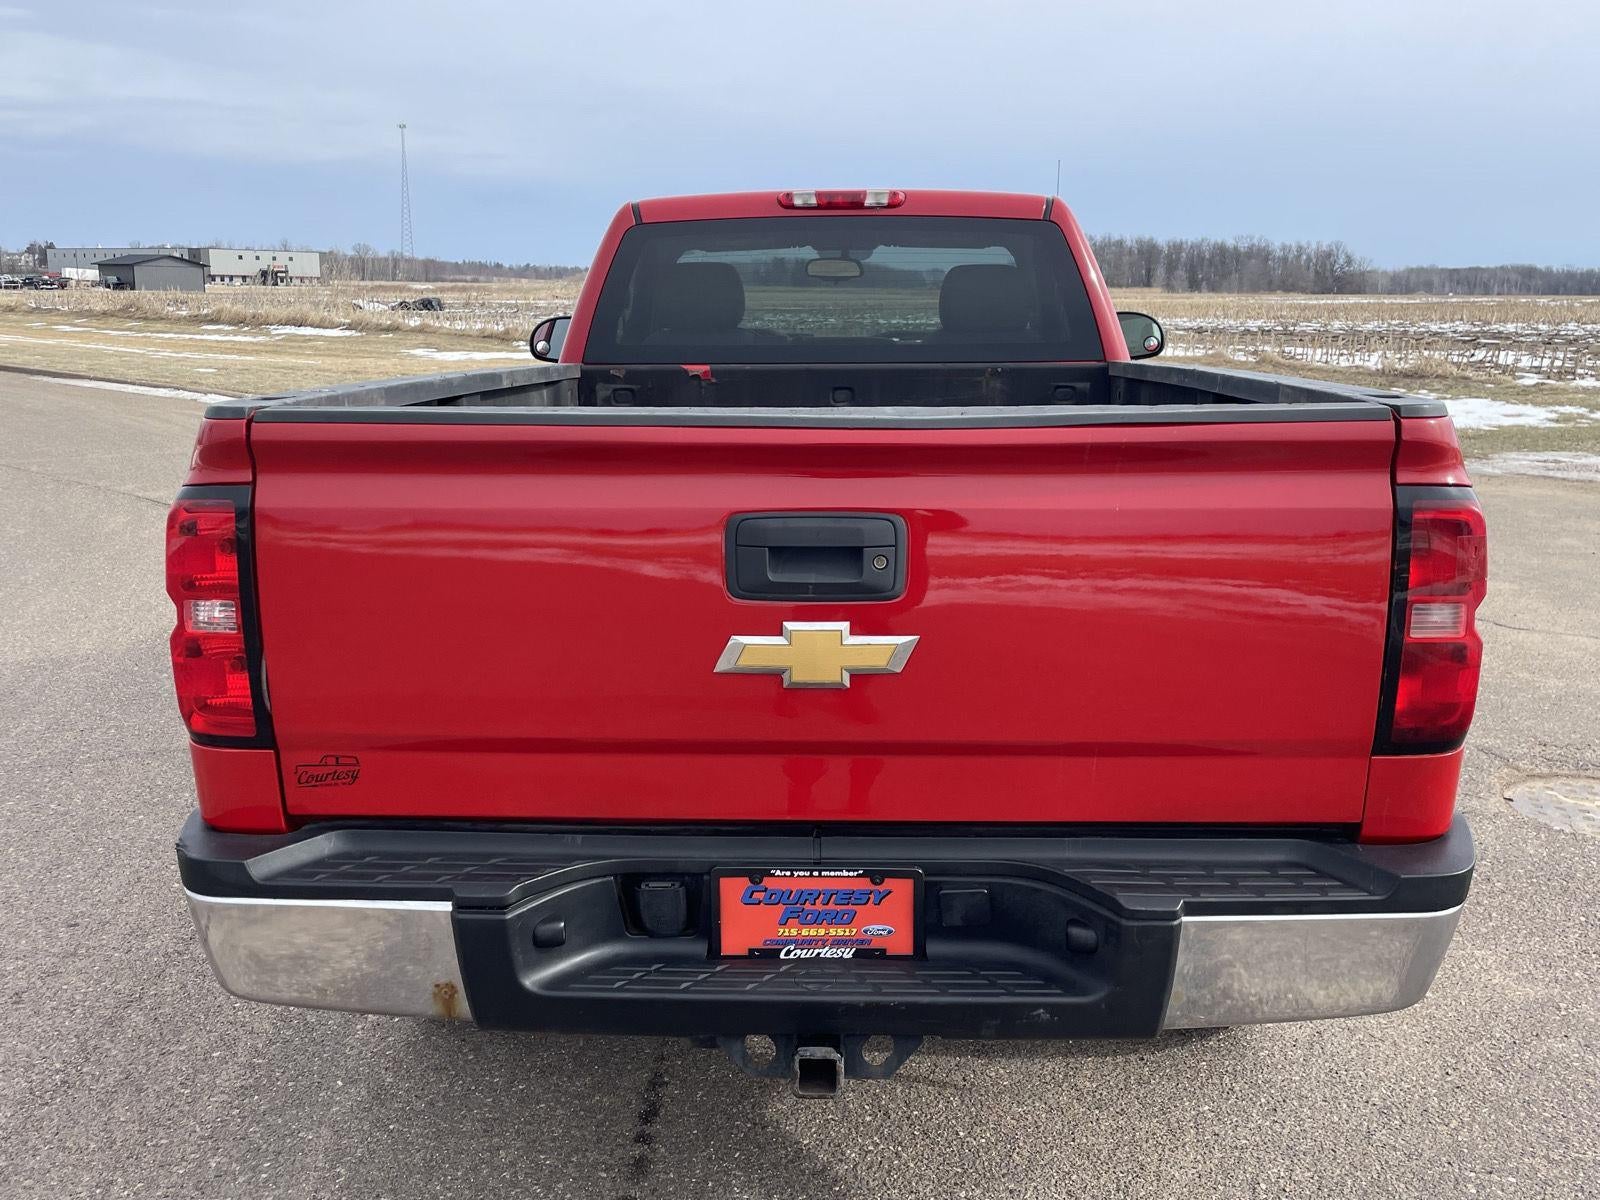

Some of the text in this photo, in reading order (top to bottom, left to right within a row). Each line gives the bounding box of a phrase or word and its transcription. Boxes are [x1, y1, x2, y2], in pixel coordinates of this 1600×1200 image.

[298, 769, 360, 785] Courtesy
[778, 906, 857, 926] FORD
[777, 928, 857, 936] 715-669-5517
[867, 927, 888, 936] Ford
[780, 945, 856, 959] Courtesy
